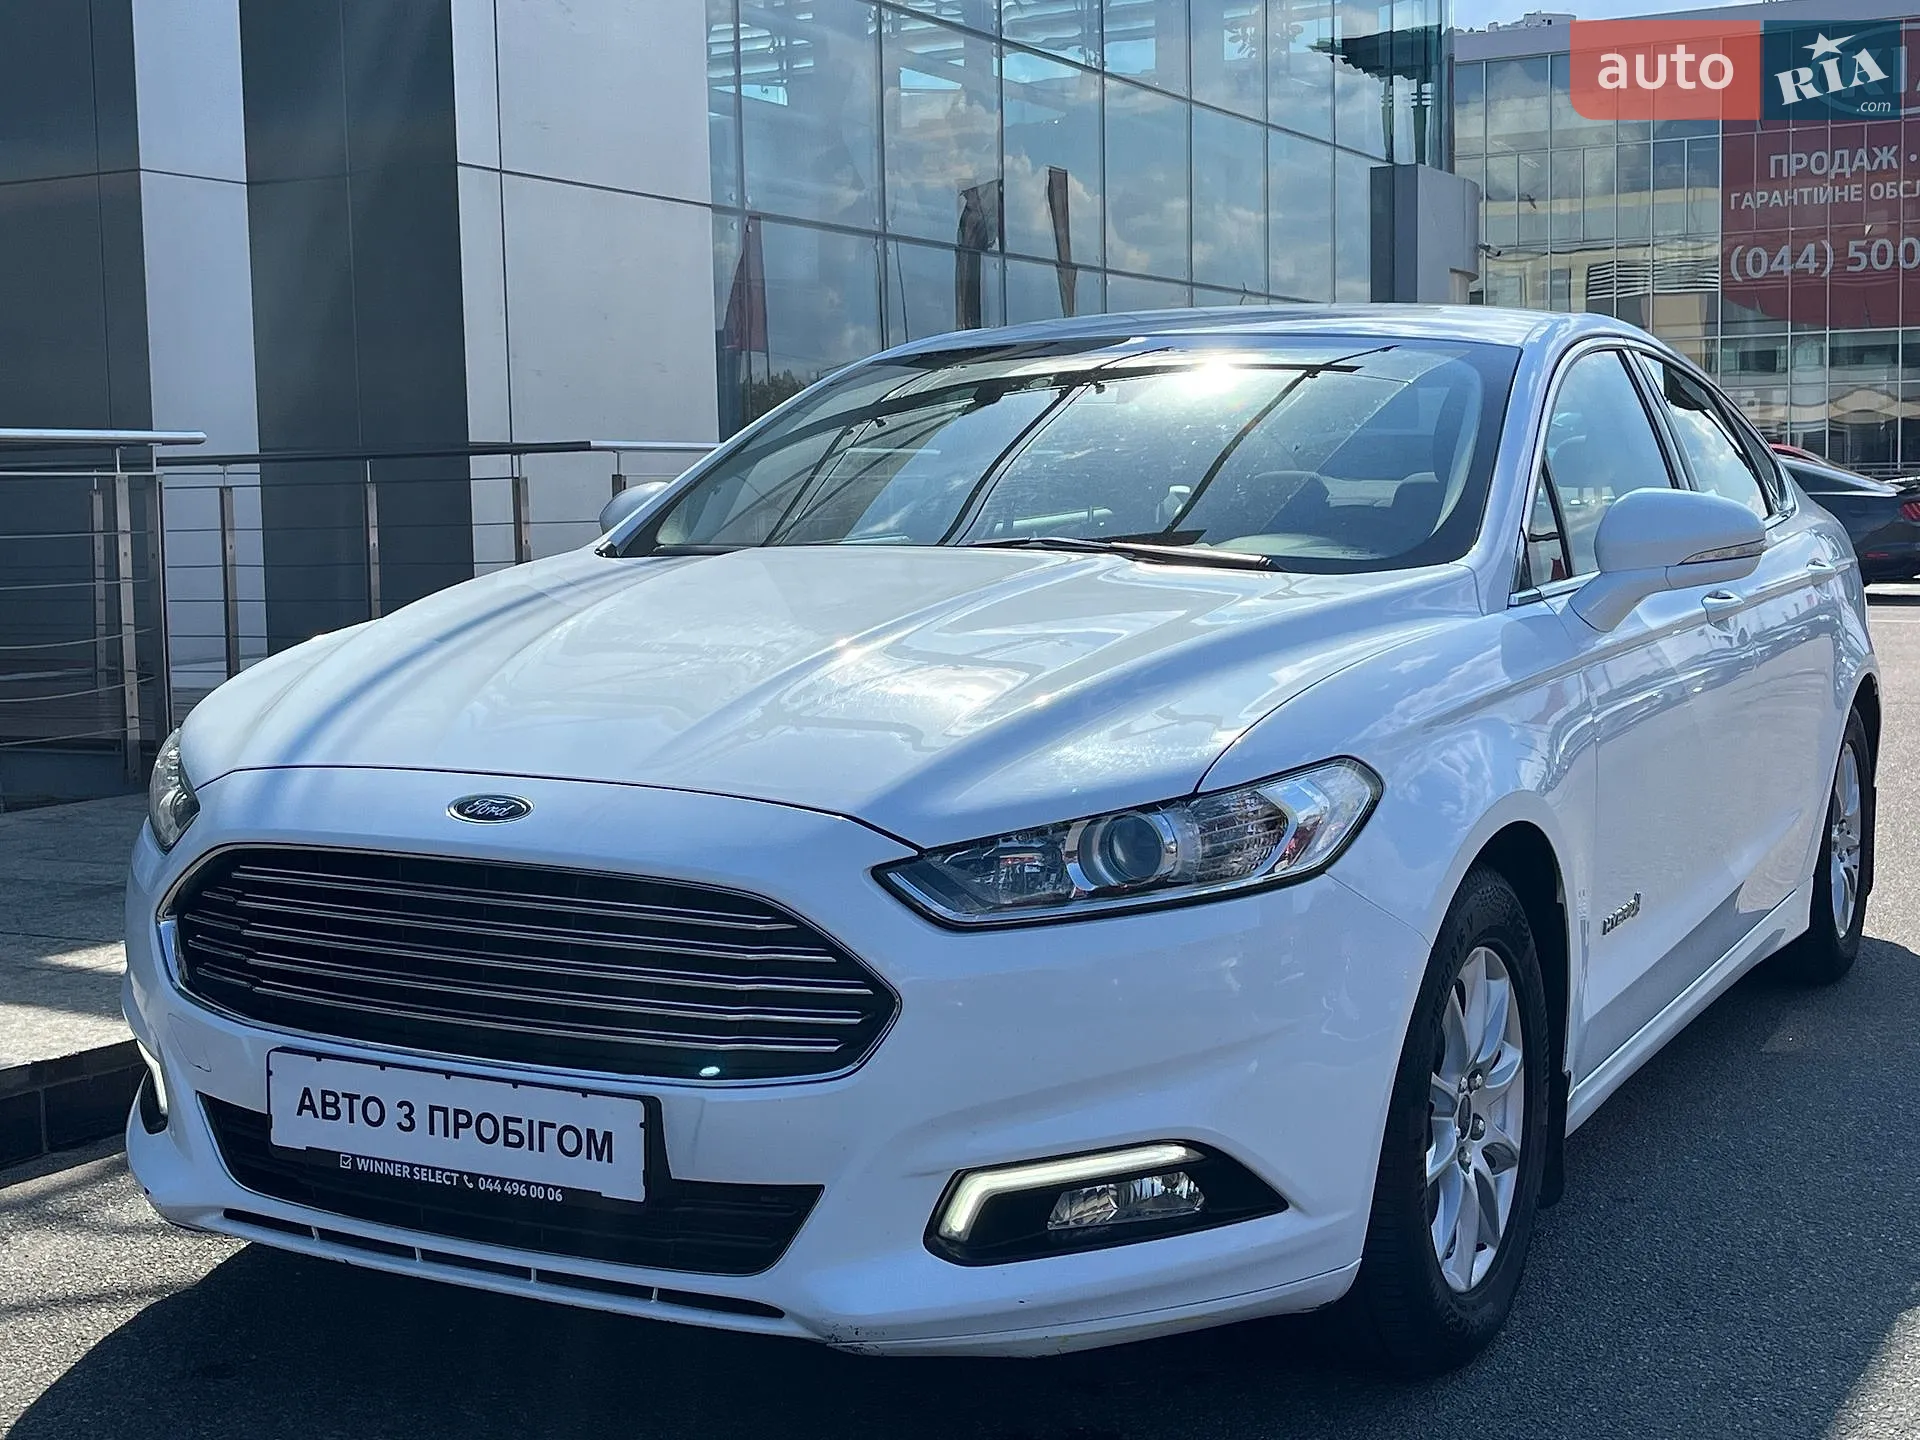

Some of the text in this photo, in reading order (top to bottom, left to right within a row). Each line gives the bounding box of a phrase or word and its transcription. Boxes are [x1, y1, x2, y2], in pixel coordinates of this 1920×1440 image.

[1769, 145, 1899, 180] ПРОДАЖ
[1729, 183, 1863, 210] ГАРАНТІЙНЕ
[1729, 237, 1920, 283] (044) 500
[464, 799, 515, 817] Ford
[296, 1086, 386, 1128] АВТО
[428, 1104, 613, 1164] ПРОБІГОМ
[356, 1157, 563, 1203] WINNER SELECT 044 496 00 06
